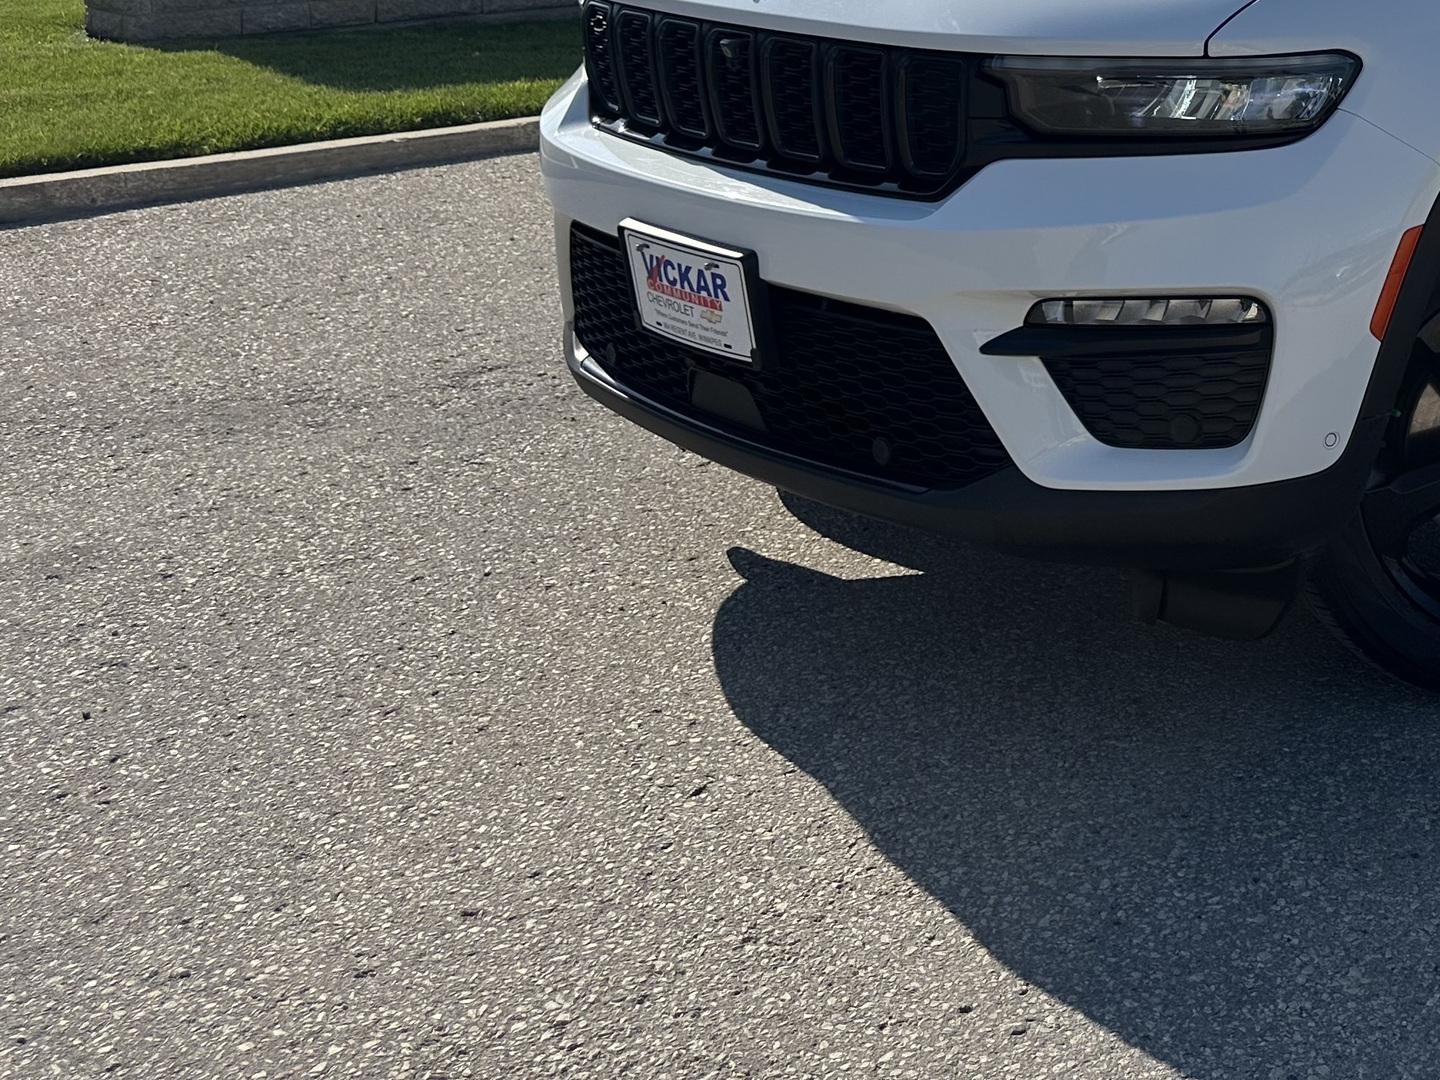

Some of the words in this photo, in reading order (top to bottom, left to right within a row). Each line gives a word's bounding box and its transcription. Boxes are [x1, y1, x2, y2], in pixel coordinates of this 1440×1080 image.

[641, 251, 730, 302] VICKAR
[647, 279, 722, 311] COMMUNITY
[647, 291, 694, 318] CHEVROLET
